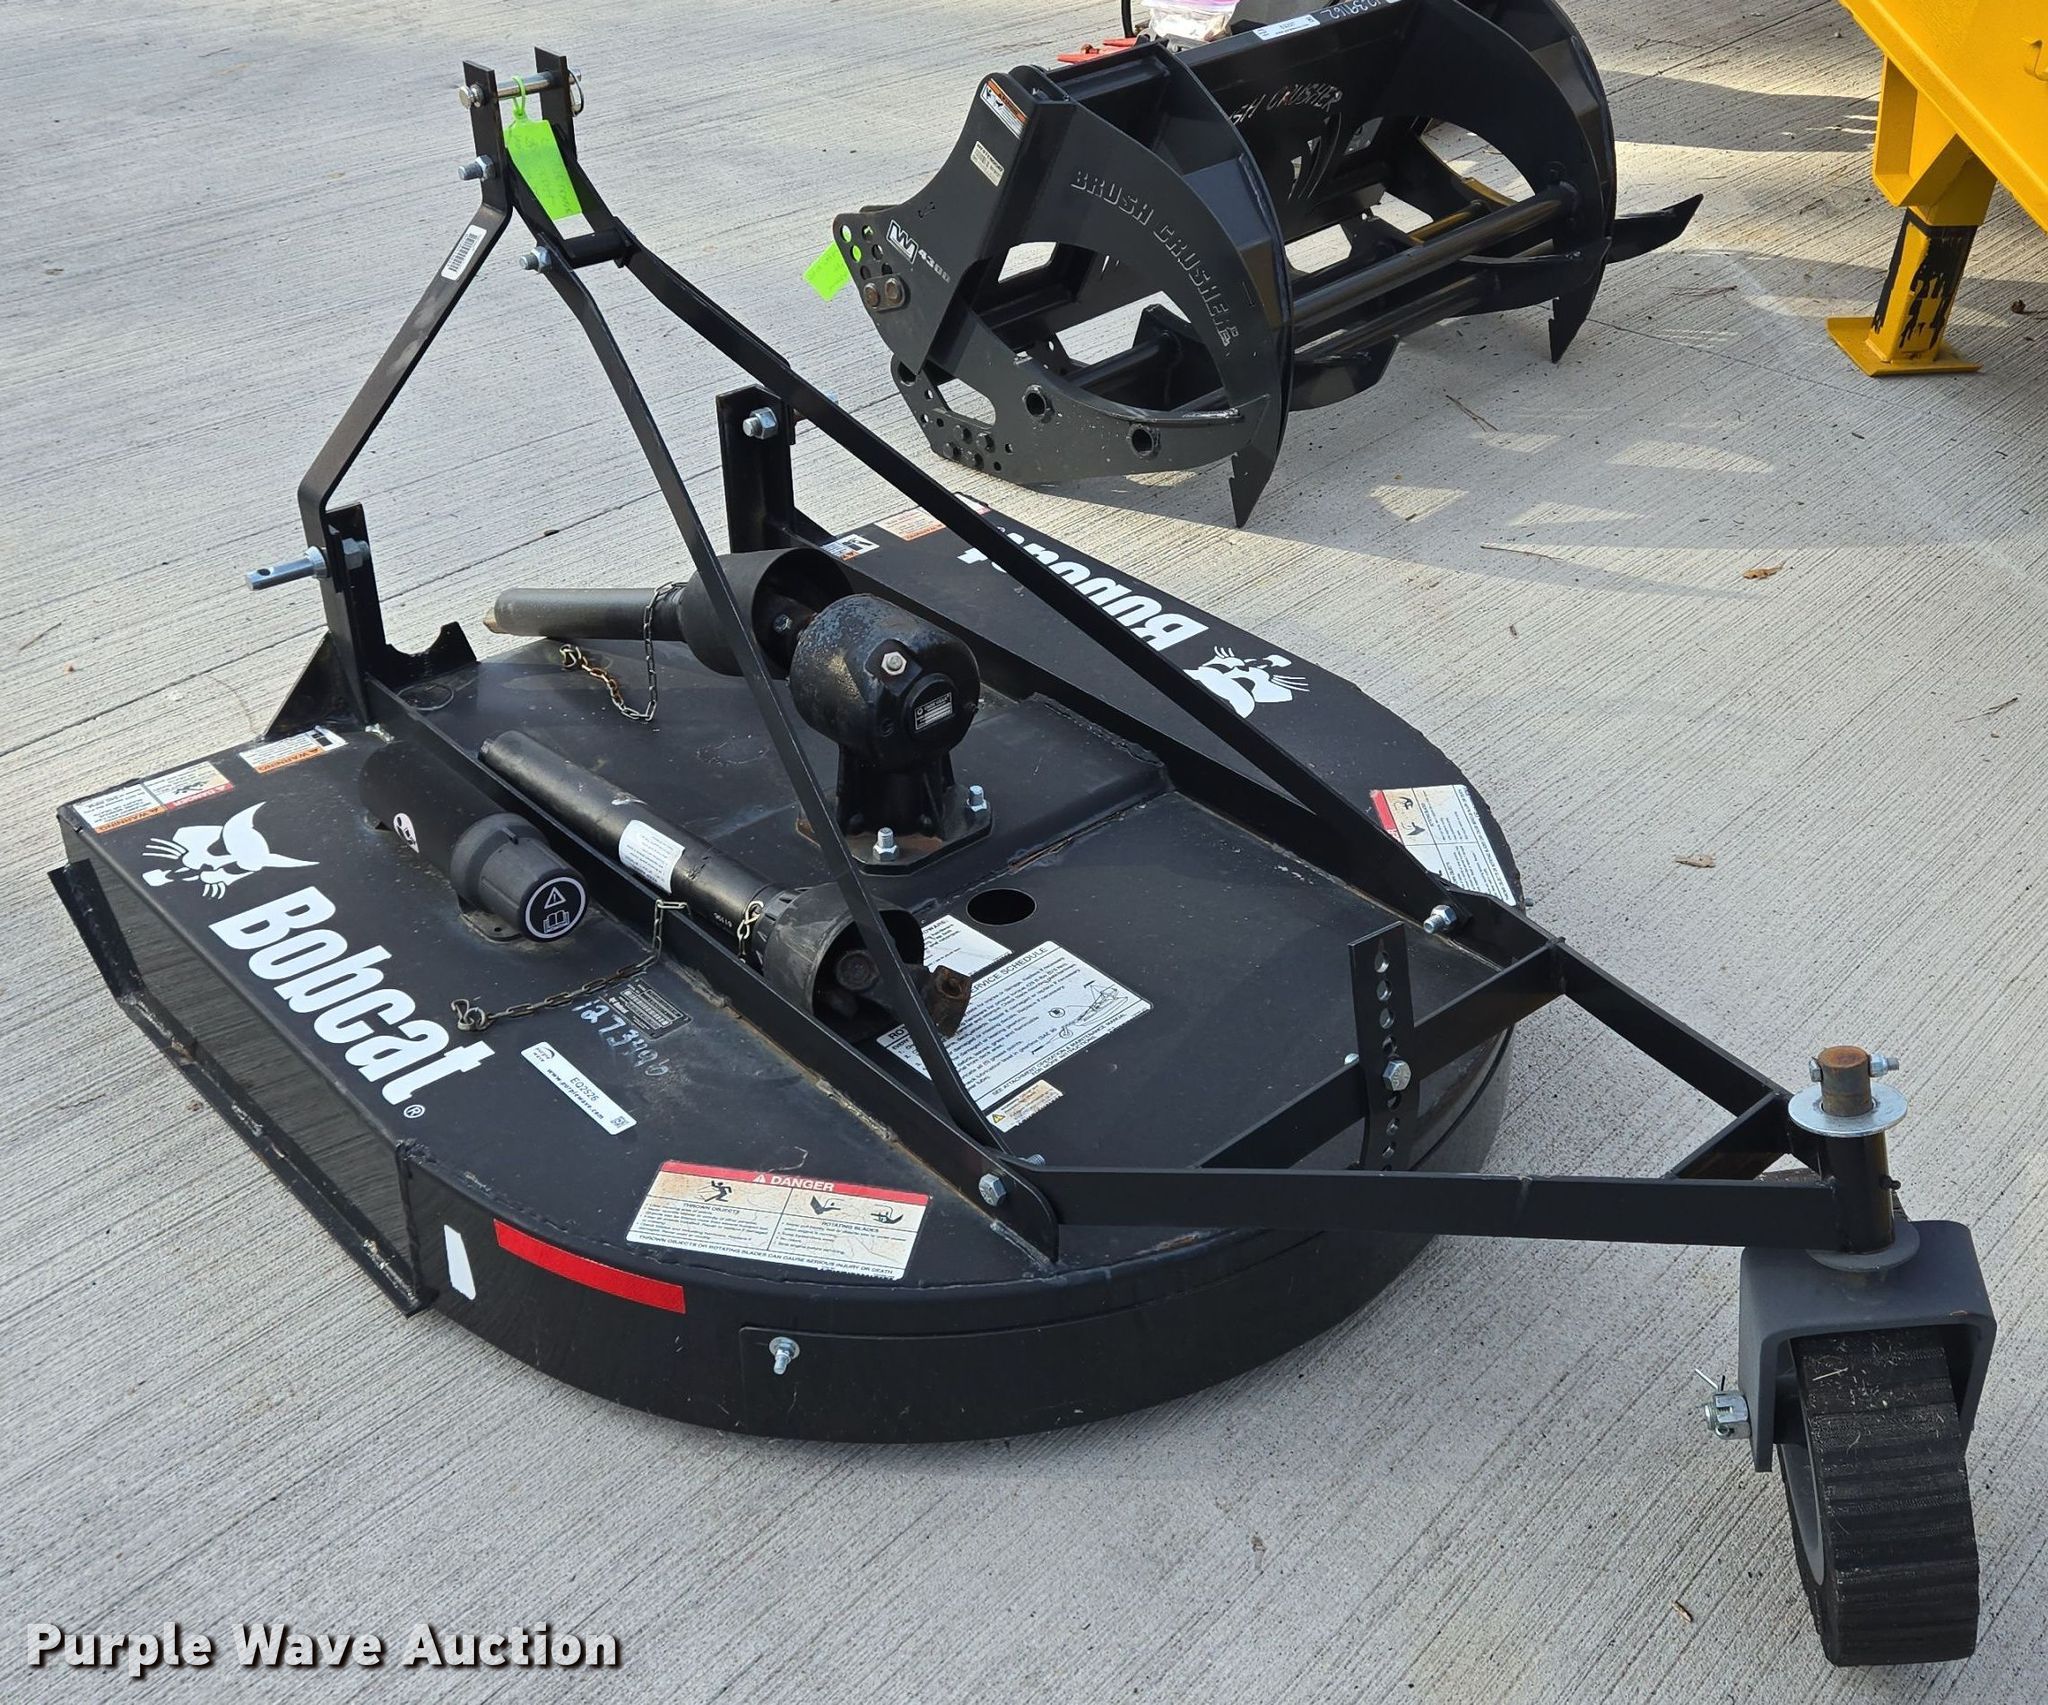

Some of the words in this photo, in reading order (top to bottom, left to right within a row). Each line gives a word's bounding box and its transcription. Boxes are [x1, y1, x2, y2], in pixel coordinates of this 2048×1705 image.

[1070, 171, 1154, 226] BRUSH
[1153, 225, 1239, 347] CRUSHER
[208, 886, 495, 1105] Bobcat
[965, 972, 1003, 994] ERVICE
[997, 945, 1049, 975] SCHEDULE
[546, 1068, 605, 1120] www.purplewave.com
[769, 1175, 836, 1192] DANGER
